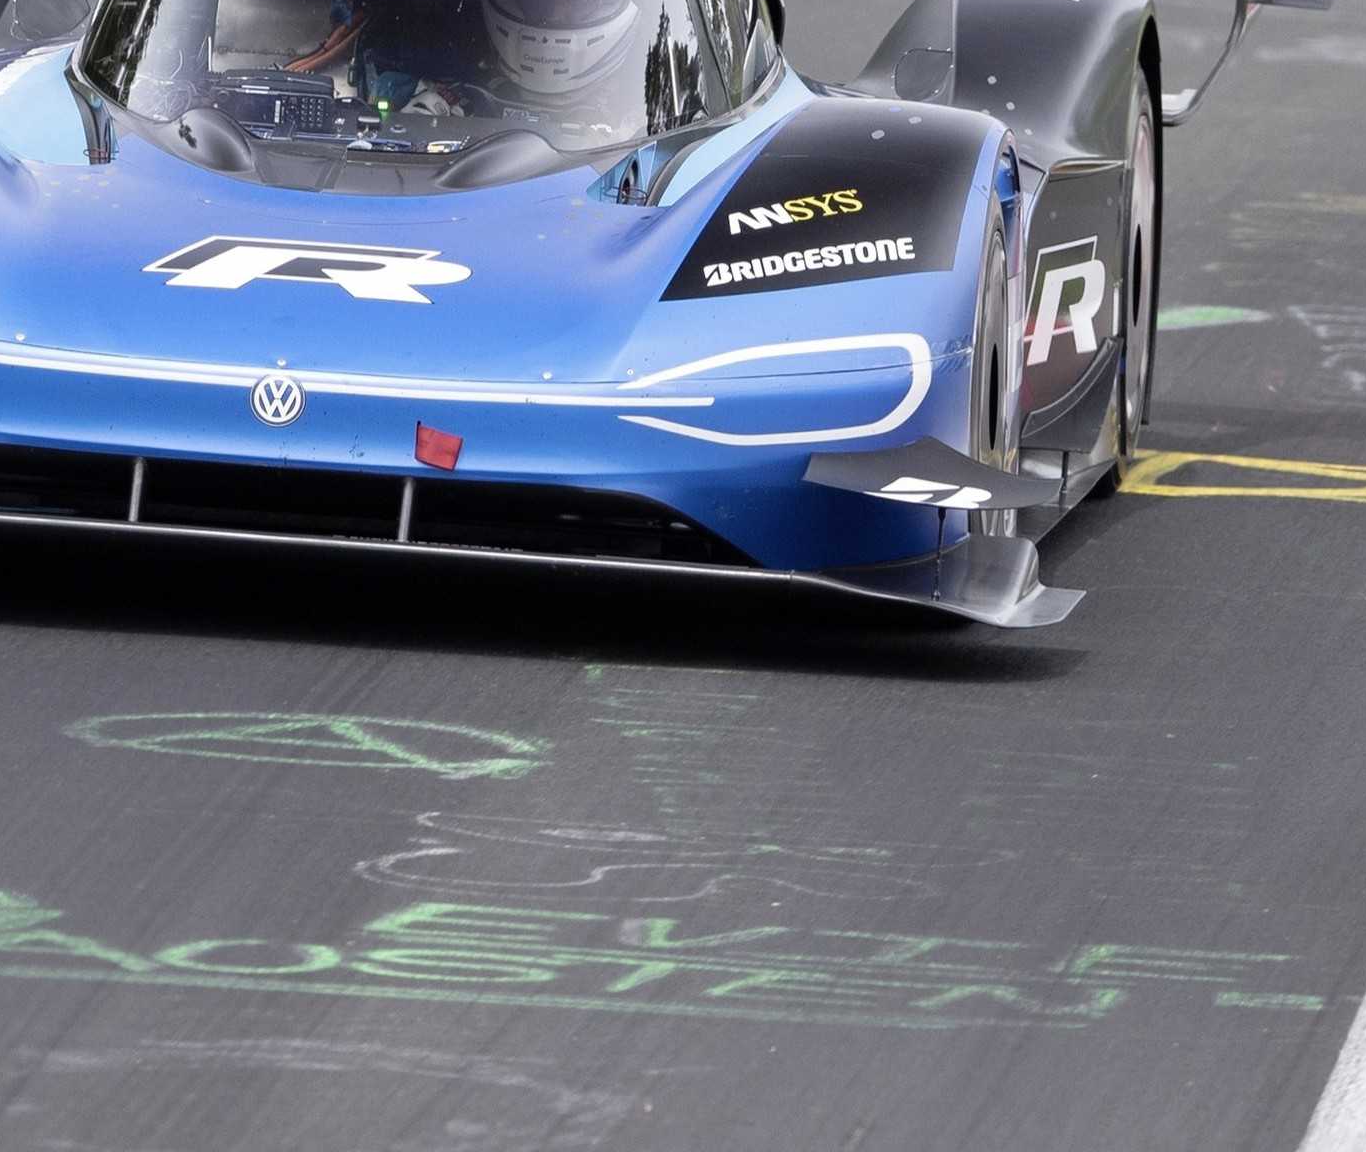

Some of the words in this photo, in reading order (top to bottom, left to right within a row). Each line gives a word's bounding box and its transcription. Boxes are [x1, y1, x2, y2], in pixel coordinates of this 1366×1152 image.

[728, 189, 863, 235] ANSYS
[140, 235, 473, 304] R
[703, 237, 916, 287] BRIDGESTONE
[1024, 235, 1106, 366] R
